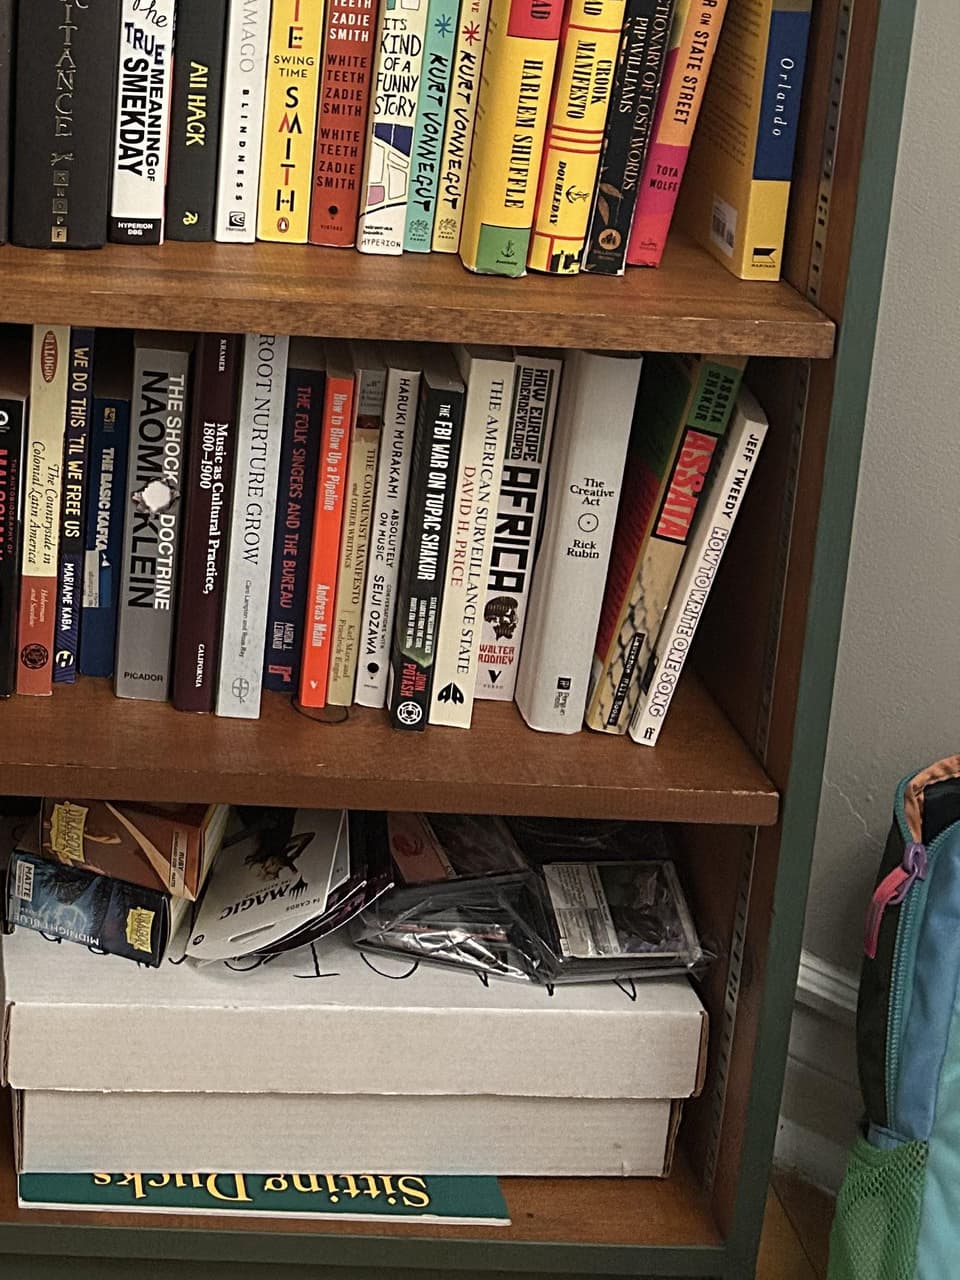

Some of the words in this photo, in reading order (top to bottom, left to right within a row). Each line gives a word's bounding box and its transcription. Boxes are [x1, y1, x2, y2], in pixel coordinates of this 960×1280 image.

[124, 22, 165, 66] TRUE
[329, 28, 368, 43] SMITH
[332, 13, 370, 26] ZADIE
[273, 55, 314, 66] SWING
[278, 68, 308, 78] TIME
[327, 54, 367, 68] WHITE
[327, 70, 365, 83] TEETH
[565, 40, 596, 120] MANIFESTO
[118, 58, 149, 177] SMEKDAY
[515, 59, 544, 129] HARLEM
[772, 57, 795, 137] Orlando
[276, 86, 302, 212] SMITH
[504, 133, 533, 210] SHUFFLE
[254, 333, 276, 393] ROOT
[168, 374, 185, 412] THE
[395, 378, 411, 425] HARUKI
[489, 380, 504, 411] THE
[510, 367, 534, 460] UNDERDEVELOPED
[162, 415, 183, 484] SHOCK
[247, 398, 271, 498] NURTURE
[386, 430, 405, 499] MURAKAMI
[477, 415, 499, 502] AMERICAN
[742, 433, 760, 463] JEFF
[570, 486, 614, 498] Creative
[723, 468, 749, 519] TWEEDY
[242, 503, 263, 565] GROW
[566, 548, 600, 559] Rubin
[154, 513, 176, 611] DOCTRINE
[462, 505, 489, 626] SURVEILLANCE
[456, 628, 474, 675] STATE
[23, 863, 34, 898] MATTE
[219, 883, 290, 921] MAGIC
